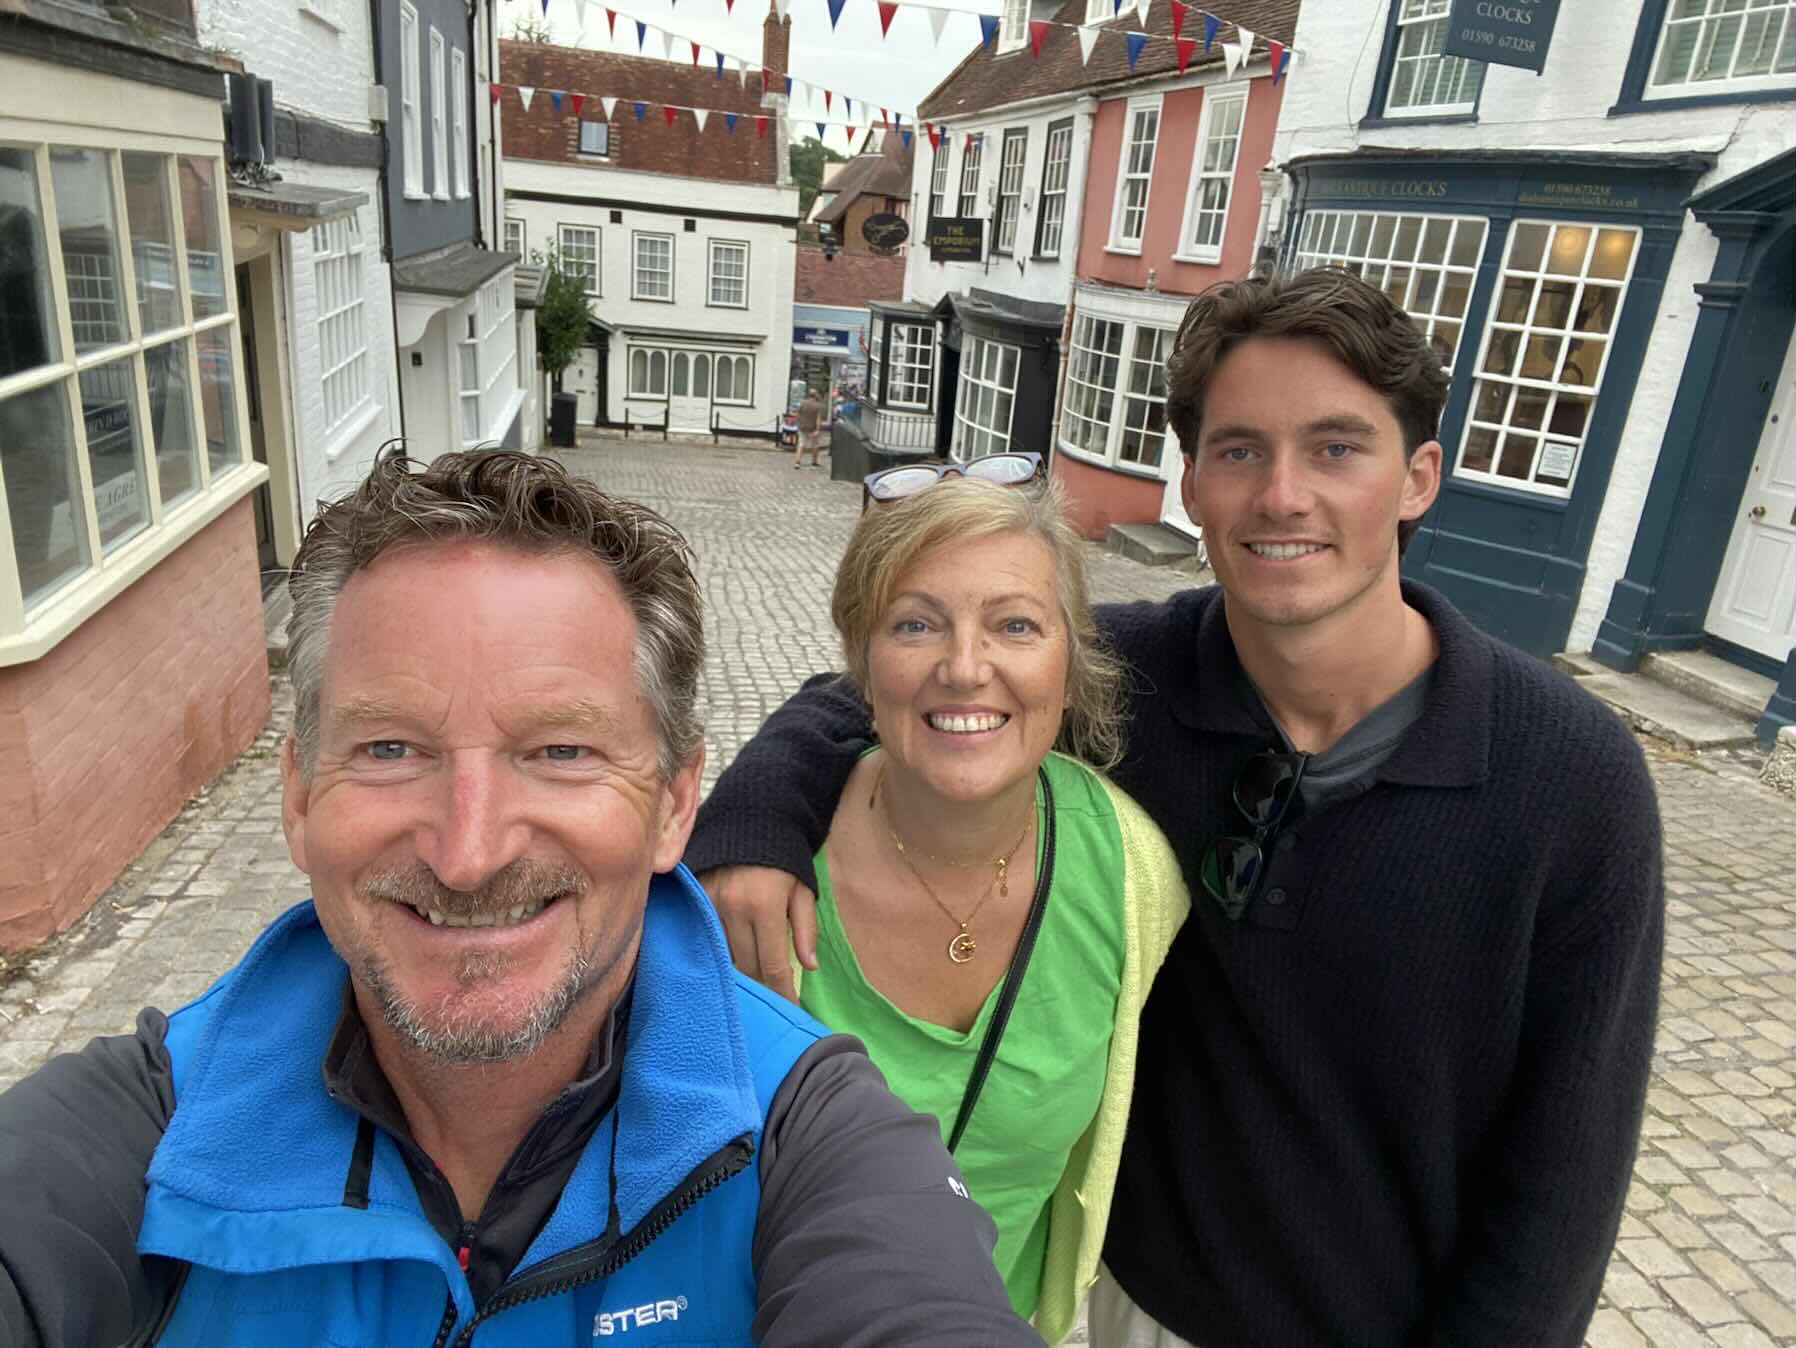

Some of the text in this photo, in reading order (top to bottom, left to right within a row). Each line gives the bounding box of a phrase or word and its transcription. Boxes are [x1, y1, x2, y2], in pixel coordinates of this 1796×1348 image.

[1476, 2, 1533, 24] CLOCKS
[1462, 28, 1494, 45] 01590
[1392, 180, 1448, 197] CLOCKS
